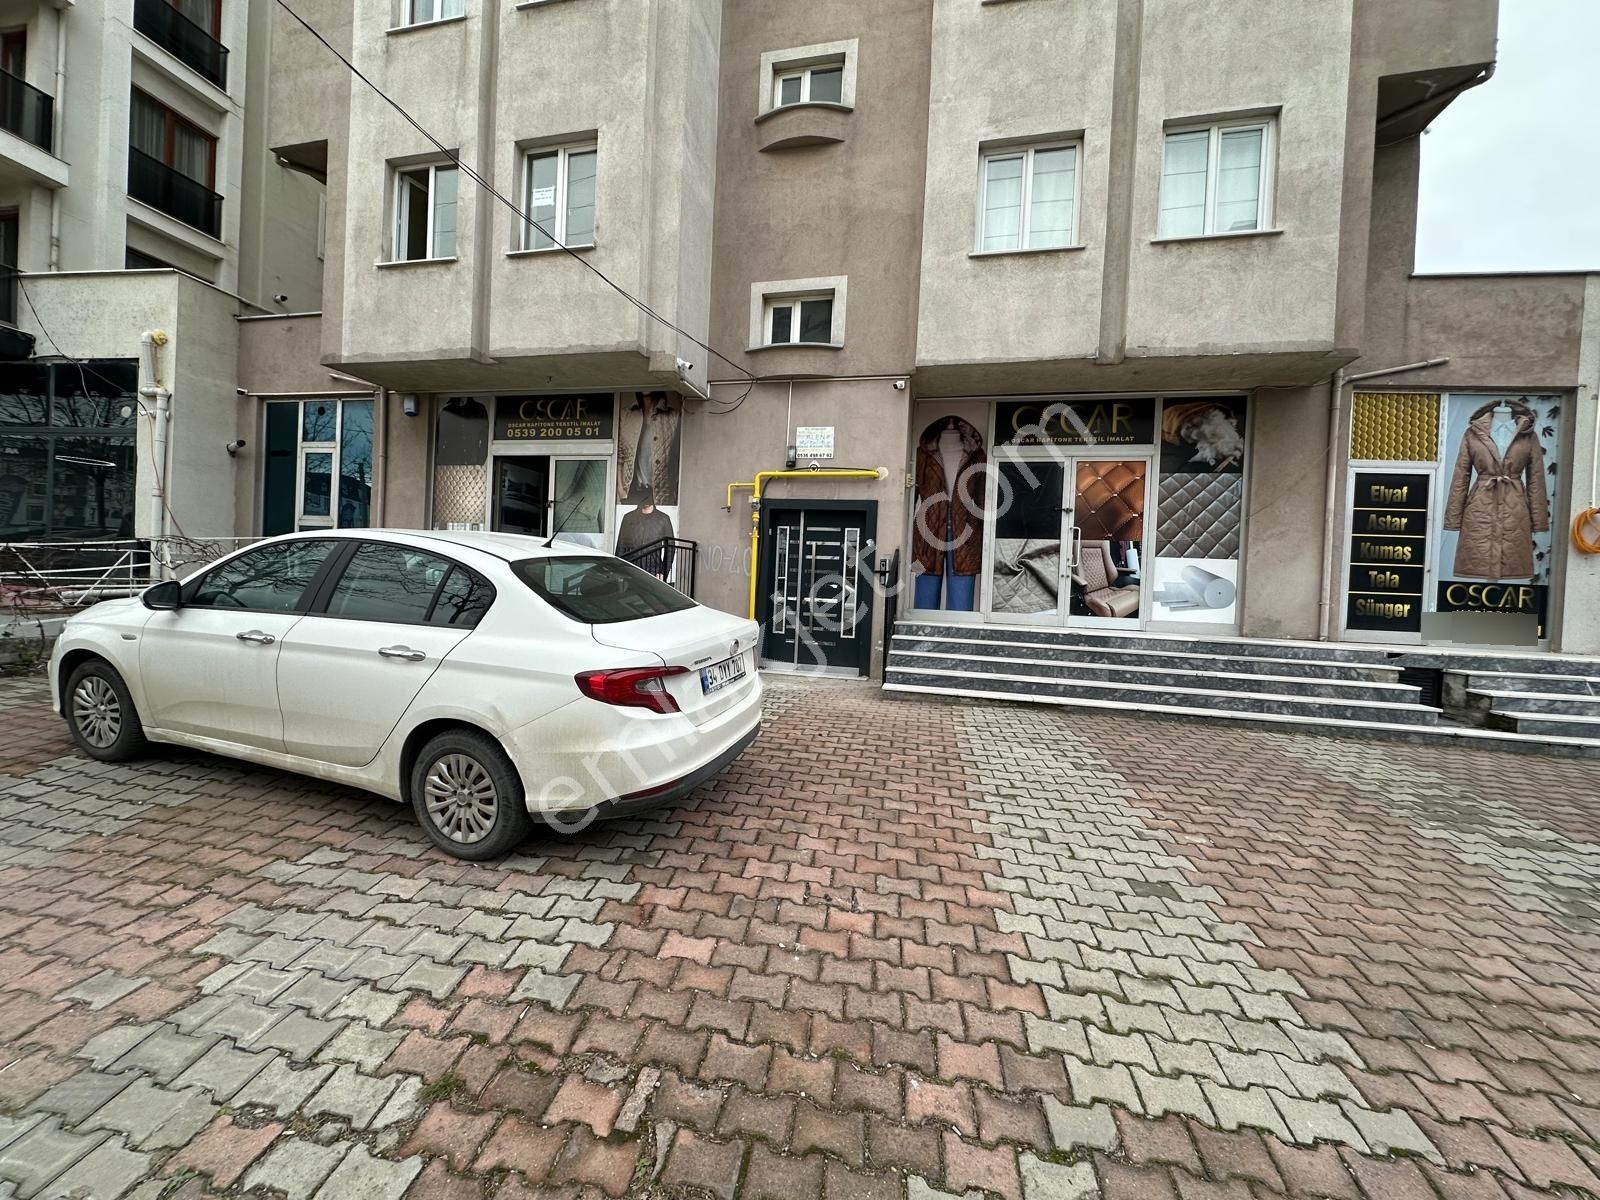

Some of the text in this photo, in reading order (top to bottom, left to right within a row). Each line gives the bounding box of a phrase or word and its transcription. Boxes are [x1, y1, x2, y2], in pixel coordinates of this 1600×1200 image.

[1011, 403, 1134, 434] OCAR
[507, 427, 600, 438] 0539 200 05 01
[1370, 485, 1408, 505] Elyaf
[1367, 513, 1408, 531] Astar
[1360, 542, 1412, 562] Kumaş
[1368, 570, 1400, 589] Tela
[1446, 583, 1535, 609] OSCAR
[1355, 598, 1411, 619] Sünger
[707, 666, 718, 686] 34
